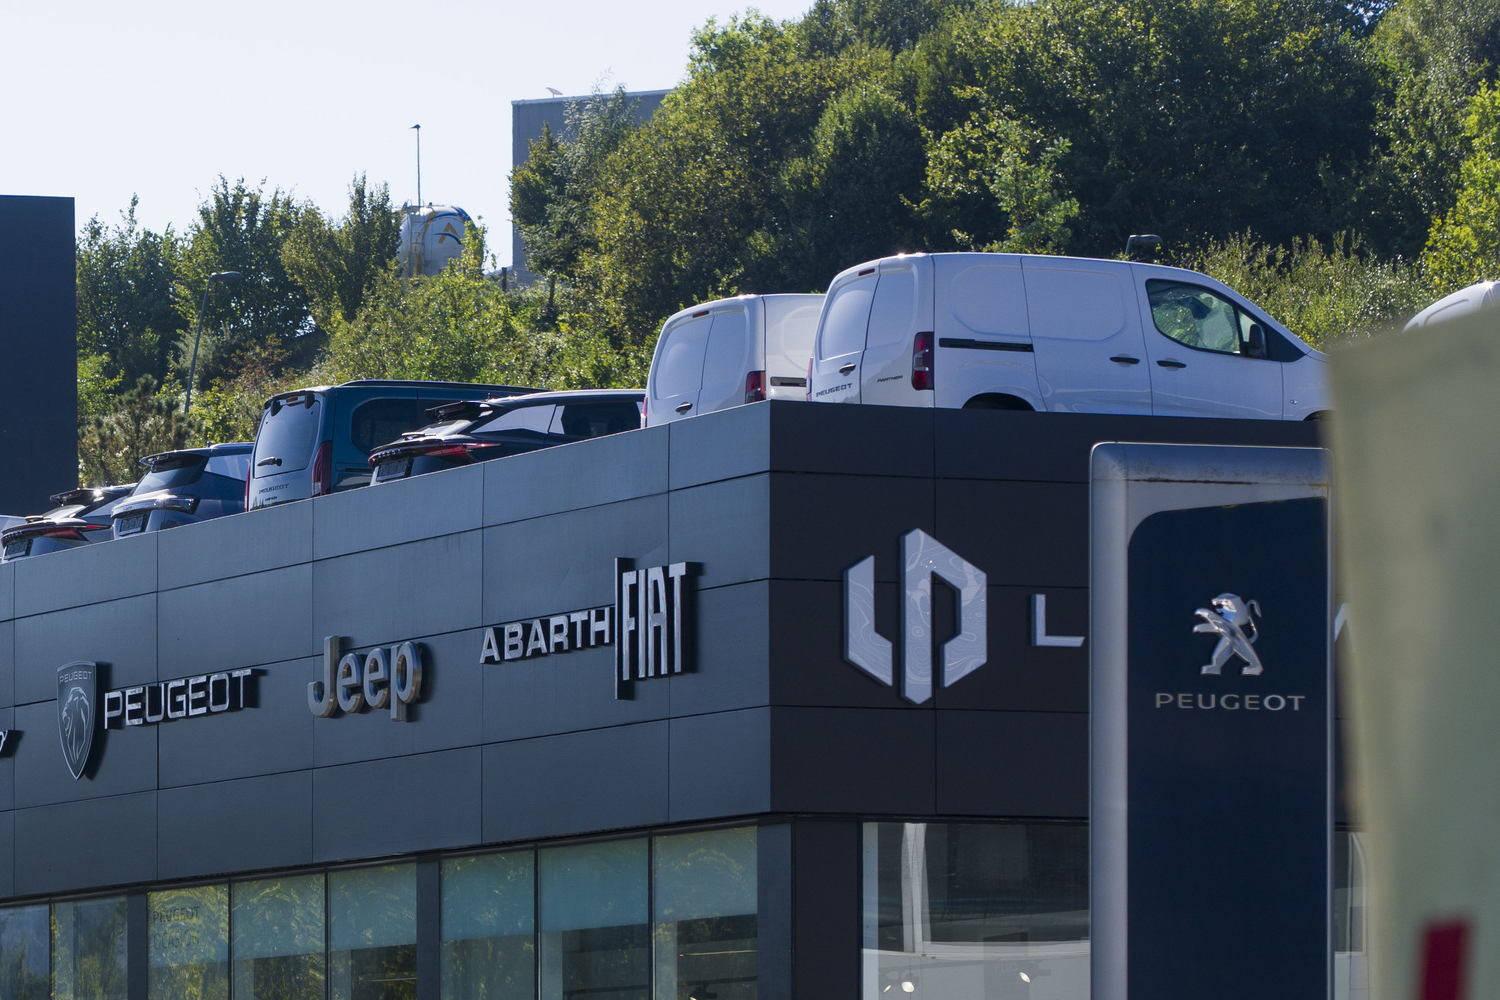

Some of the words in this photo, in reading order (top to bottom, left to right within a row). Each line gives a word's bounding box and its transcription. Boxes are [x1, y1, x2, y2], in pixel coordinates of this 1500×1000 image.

[816, 383, 852, 397] PEUGEOT
[479, 606, 610, 664] ABARTH
[621, 561, 687, 681] FIAT
[59, 671, 92, 685] PEUGEOT
[306, 635, 420, 722] Jeep
[104, 668, 252, 730] PEUGEOT
[1155, 692, 1306, 711] PEUGEOT
[153, 905, 200, 923] PEUGEOT
